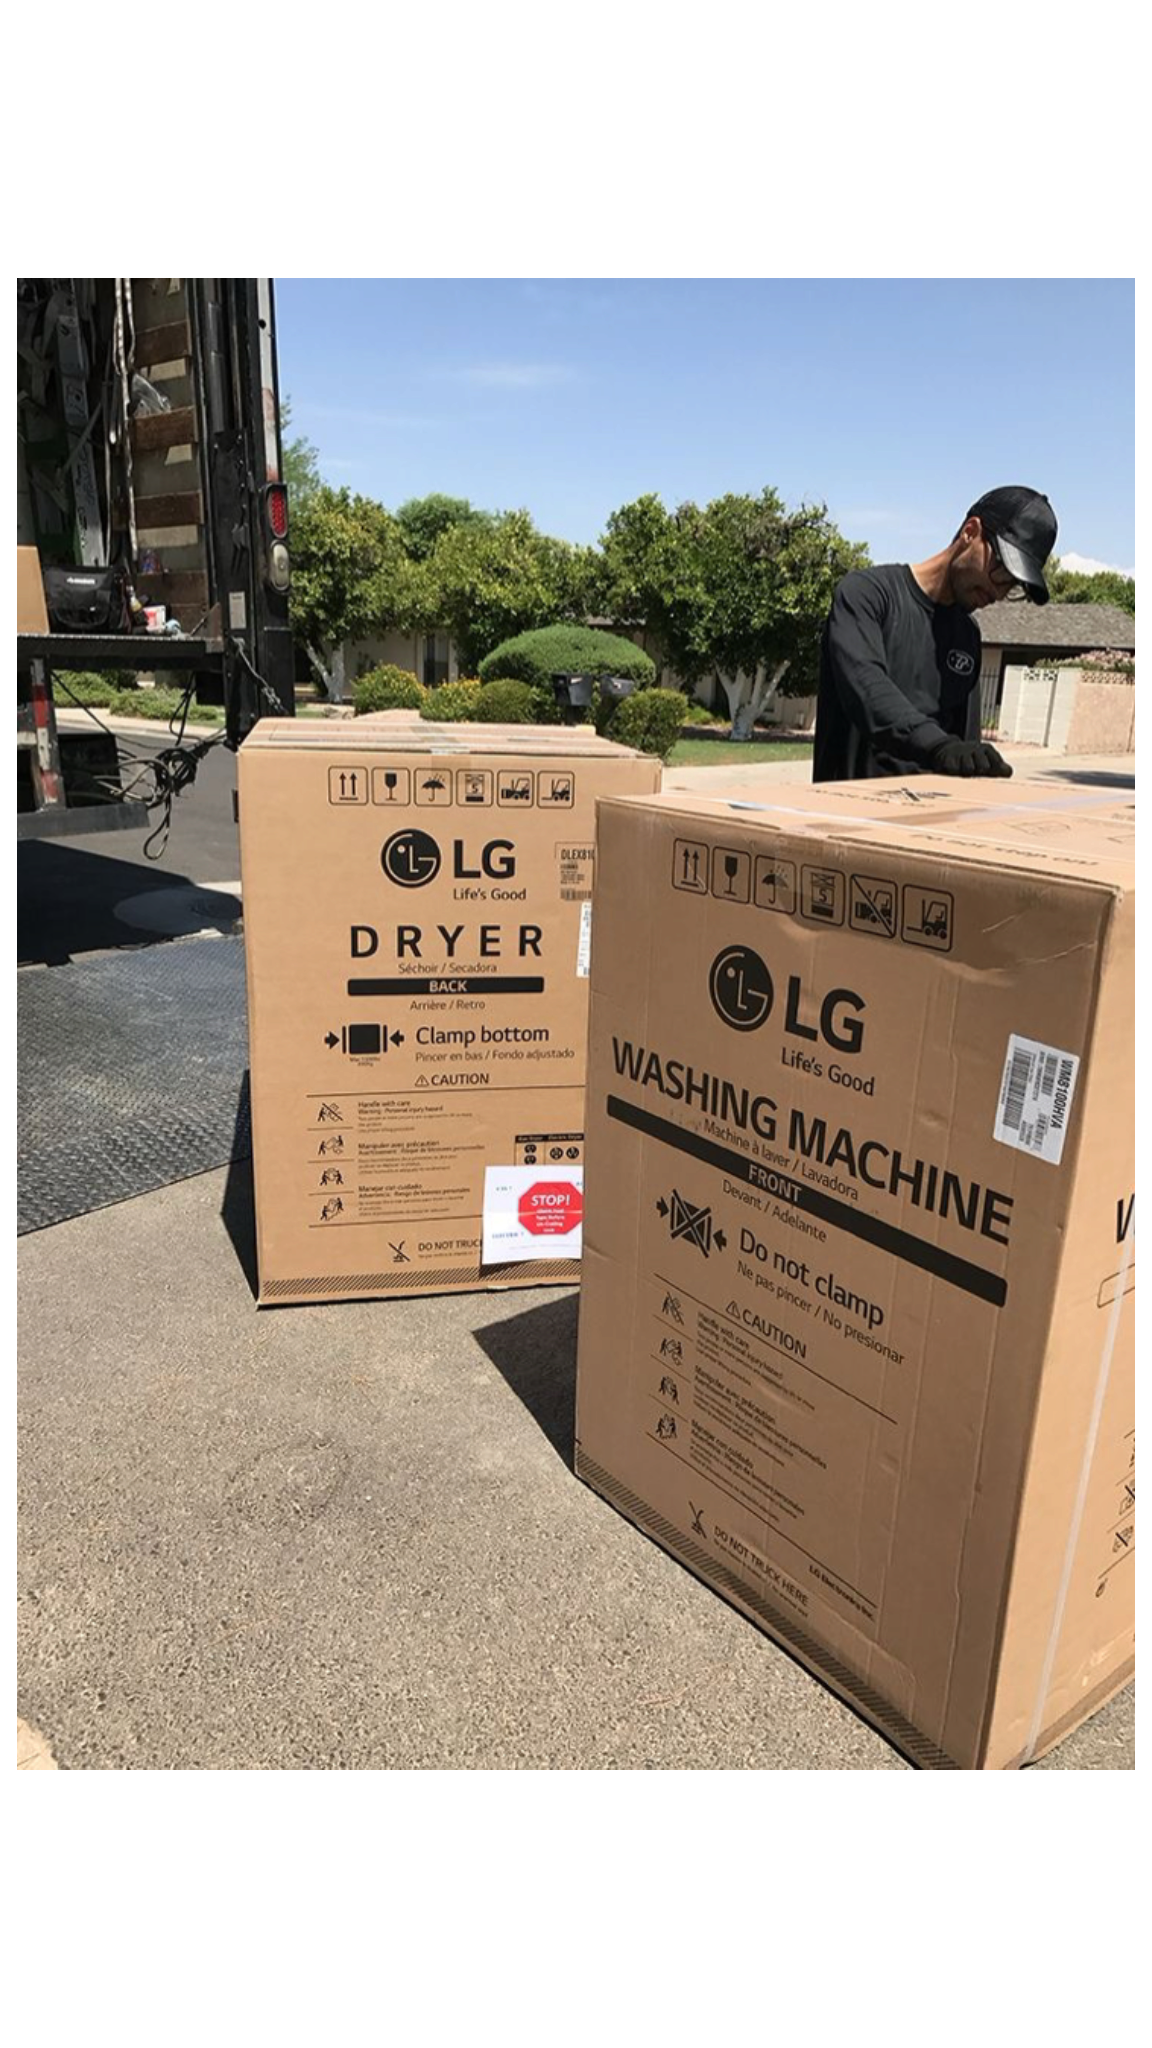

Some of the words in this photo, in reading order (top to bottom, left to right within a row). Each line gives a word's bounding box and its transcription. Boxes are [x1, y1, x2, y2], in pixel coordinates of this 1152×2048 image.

[453, 839, 516, 879] LG
[453, 888, 487, 901] Life's
[490, 888, 526, 901] Good
[350, 925, 542, 958] DRYER
[398, 962, 439, 975] Séchoir
[440, 963, 447, 975] /
[449, 962, 497, 974] Secadora
[429, 980, 467, 992] BACK
[410, 1000, 447, 1011] Arrière
[449, 1000, 455, 1011] /
[456, 1000, 485, 1010] Retro
[784, 975, 866, 1054] LG
[415, 1051, 447, 1062] Pincer
[449, 1053, 463, 1061] en
[465, 1050, 483, 1060] bas
[484, 1050, 491, 1060] /
[492, 1049, 523, 1060] Fondo
[525, 1048, 575, 1060] adjustado
[416, 1026, 476, 1047] Clamp
[481, 1025, 549, 1042] bottom
[430, 1073, 489, 1086] CAUTION
[781, 1047, 823, 1077] Life's
[828, 1064, 875, 1096] Good
[1050, 1059, 1074, 1130] WM8100HVA
[612, 1036, 778, 1141] WASHING
[788, 1108, 1014, 1247] MACHINE
[704, 1118, 750, 1151] Machine
[752, 1140, 760, 1155] à
[762, 1147, 791, 1168] laver
[792, 1159, 799, 1172] /
[801, 1163, 859, 1201] Lavadora
[531, 1194, 570, 1206] STOP!
[749, 1163, 803, 1203] FRONT
[722, 1179, 763, 1211] Devant
[763, 1200, 770, 1213] /
[771, 1205, 828, 1243] Adelante
[418, 1241, 433, 1251] DO
[434, 1240, 454, 1250] NOT
[456, 1239, 482, 1249] TRUC
[740, 1227, 768, 1262] Do
[773, 1251, 810, 1287] not
[815, 1272, 884, 1330] clamp
[737, 1260, 753, 1281] Ne
[755, 1272, 775, 1292] pas
[777, 1286, 812, 1313] pincer
[814, 1306, 821, 1318] /
[823, 1309, 842, 1330] No
[844, 1322, 905, 1365] presionar
[742, 1309, 807, 1359] CAUTION
[713, 1525, 728, 1543] DO
[729, 1537, 749, 1561] NOT
[750, 1552, 780, 1583] TRUCK
[782, 1576, 809, 1607] HERE
